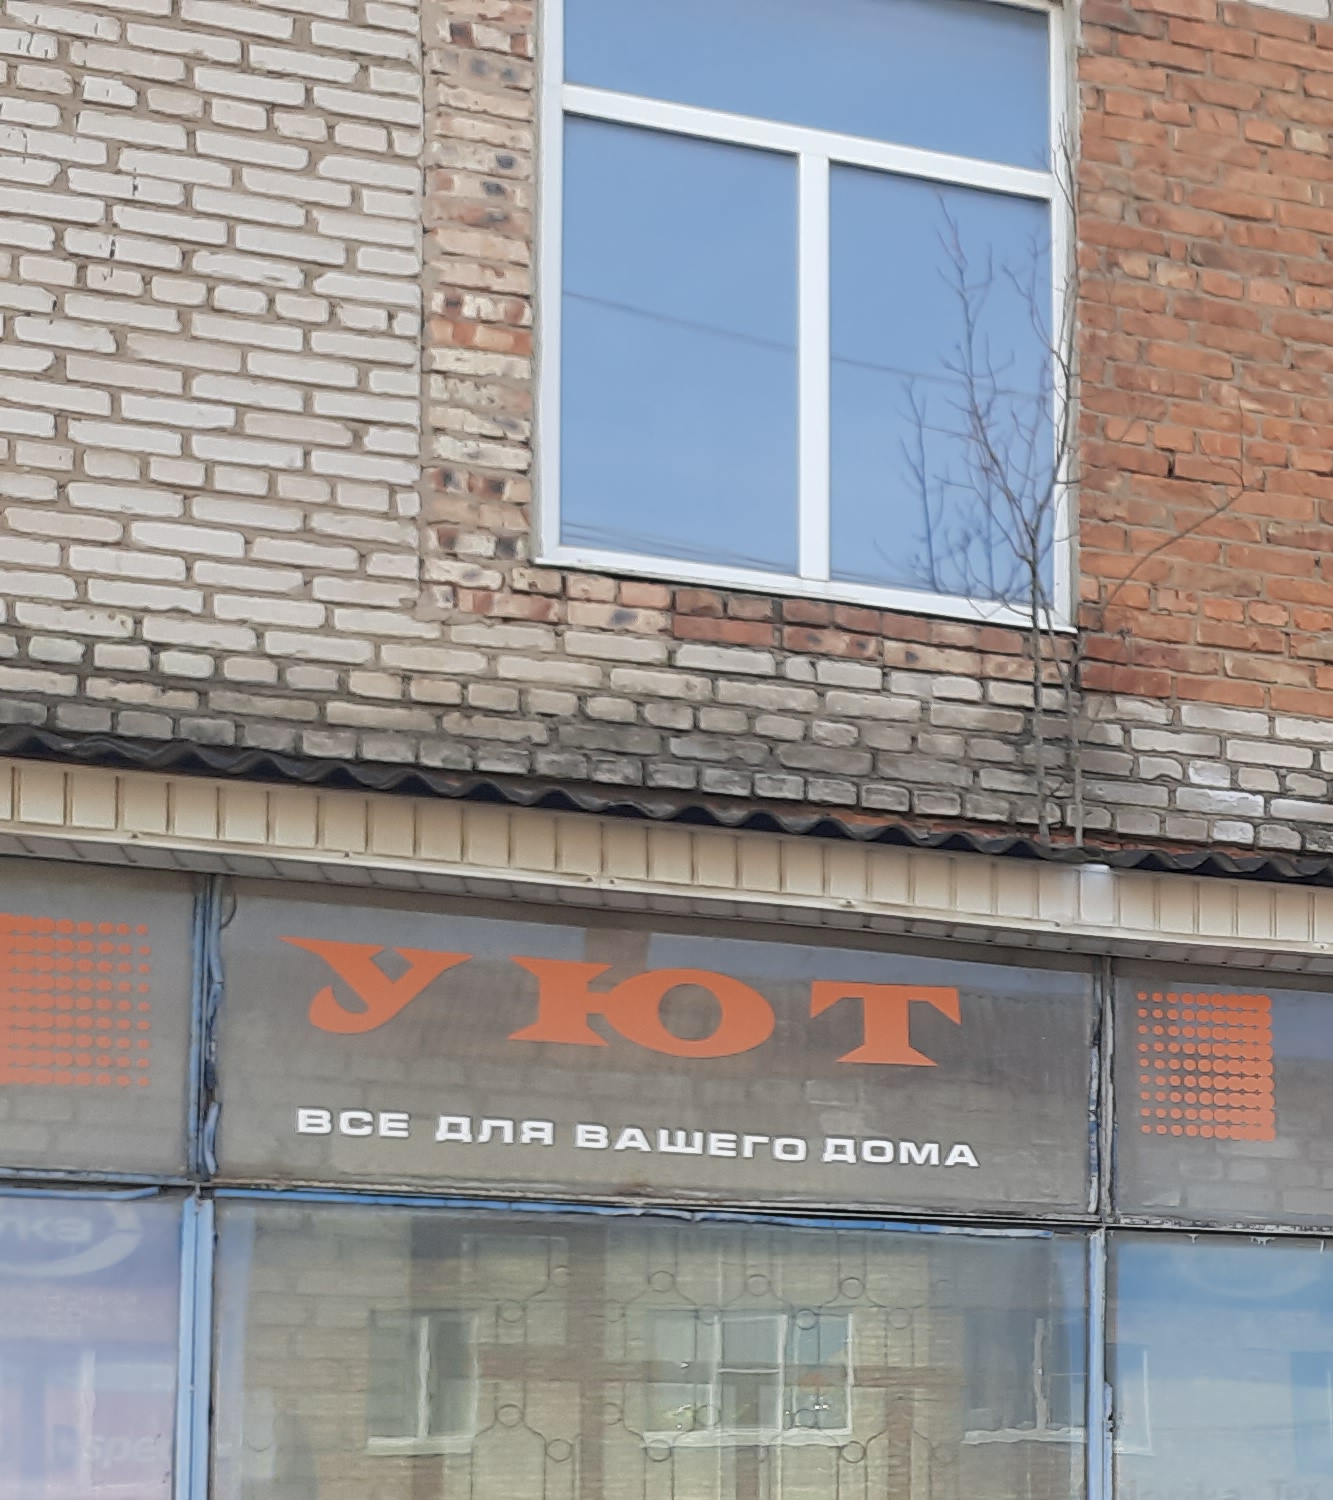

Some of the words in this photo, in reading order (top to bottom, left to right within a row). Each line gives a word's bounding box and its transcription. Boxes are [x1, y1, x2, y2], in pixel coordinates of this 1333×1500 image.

[279, 935, 962, 1067] УЮТ
[297, 1107, 410, 1139] ВСЕ
[434, 1113, 555, 1147] ДЛЯ
[574, 1121, 809, 1164] ВАШЕГО
[822, 1136, 981, 1169] ДОМА
